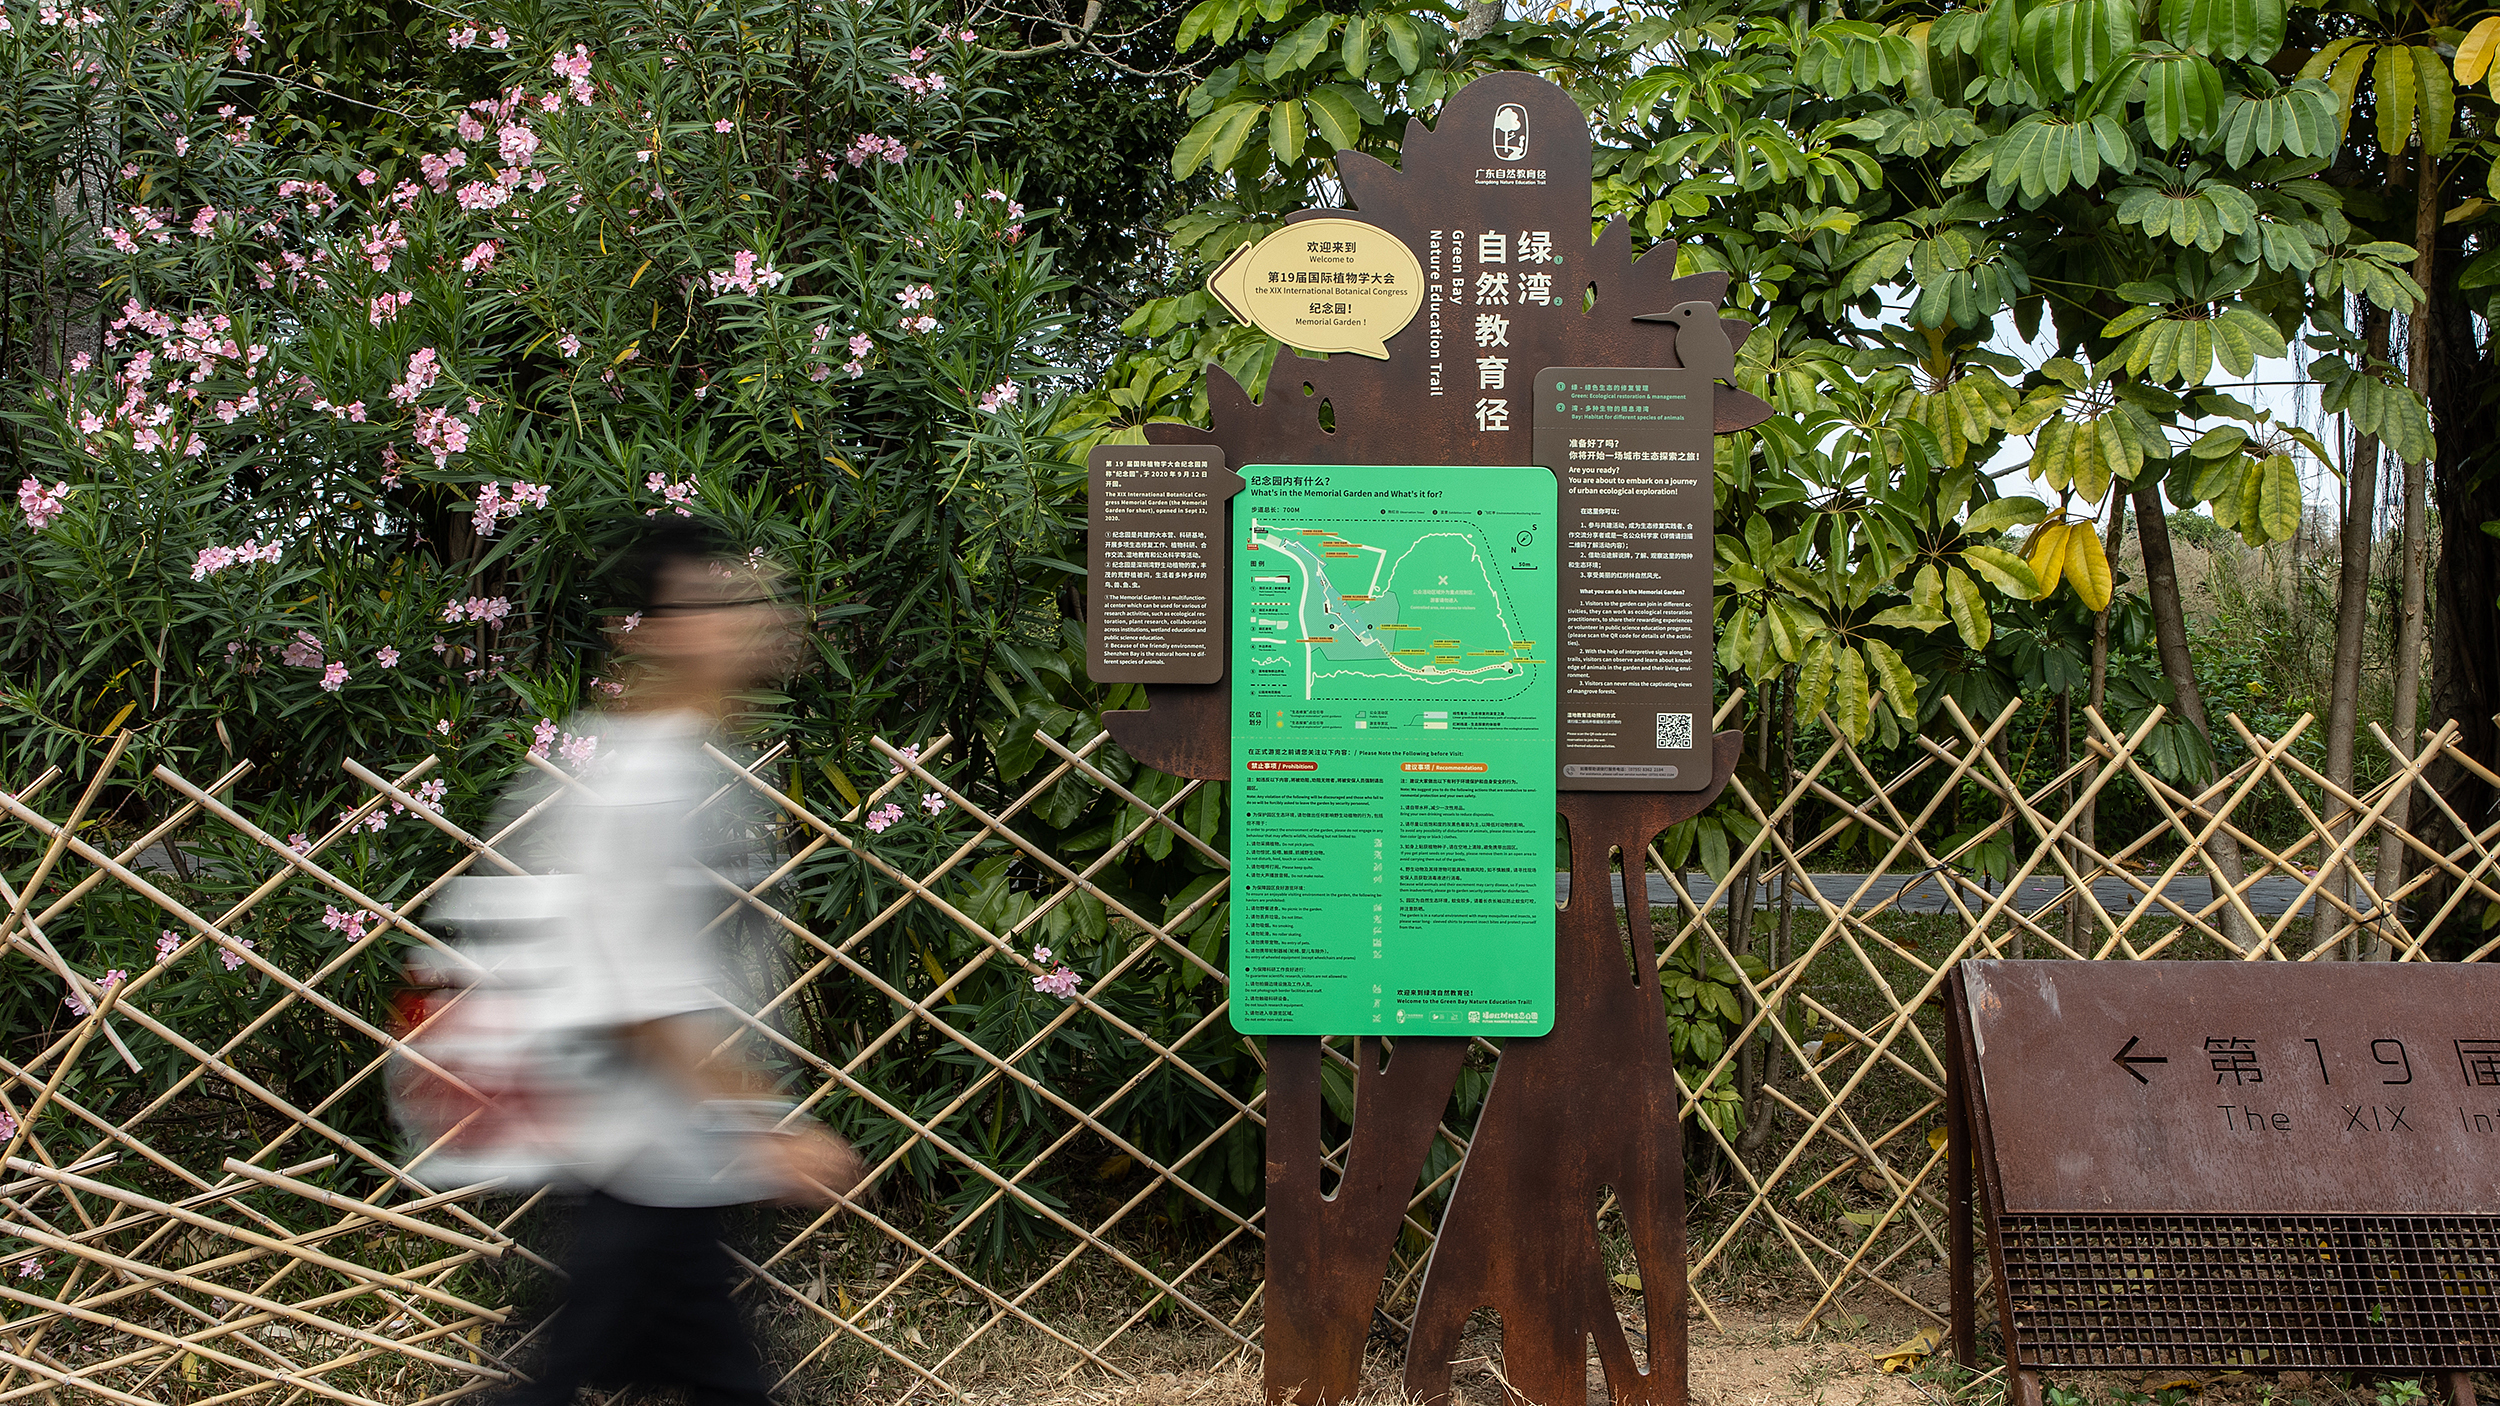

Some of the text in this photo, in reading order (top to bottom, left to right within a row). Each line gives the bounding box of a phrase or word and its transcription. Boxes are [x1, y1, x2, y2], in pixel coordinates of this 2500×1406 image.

[1475, 168, 1546, 179] 广东自然教育径
[1307, 241, 1356, 253] 欢迎来到
[1309, 255, 1345, 263] Welcome
[1449, 229, 1465, 305] Green Bay
[1517, 230, 1553, 306] 绿湾
[1268, 271, 1395, 284] 第19届国际植物学大会
[1255, 286, 1268, 294] the
[1283, 287, 1334, 295] International
[1335, 287, 1371, 295] Botanical
[1372, 287, 1408, 297] Congress
[1309, 302, 1351, 314] 纪念园！
[1429, 229, 1443, 397] Nature Education Trail
[1295, 317, 1332, 325] Memorial
[1333, 318, 1361, 326] Garden
[1475, 230, 1510, 432] 自然教育径
[1569, 438, 1619, 448] 准备好了吗？
[1569, 450, 1699, 461] 你将开始一场城市生态探索之旅！
[1582, 467, 1595, 475] you
[1596, 466, 1620, 475] ready?
[1251, 475, 1330, 486] 纪念园内有什么？
[1595, 476, 1616, 484] about
[1669, 477, 1698, 486] journey
[1251, 488, 1278, 496] What's
[1279, 488, 1287, 496] in
[1289, 489, 1302, 497] the
[1304, 489, 1342, 497] Memorial
[1343, 489, 1372, 497] Garden
[1390, 490, 1418, 498] What's
[1419, 490, 1425, 498] it
[1427, 490, 1443, 498] for?
[1568, 486, 1678, 496] of urban ecological exploration!
[2216, 1105, 2291, 1131] The
[2341, 1105, 2413, 1132] XIX
